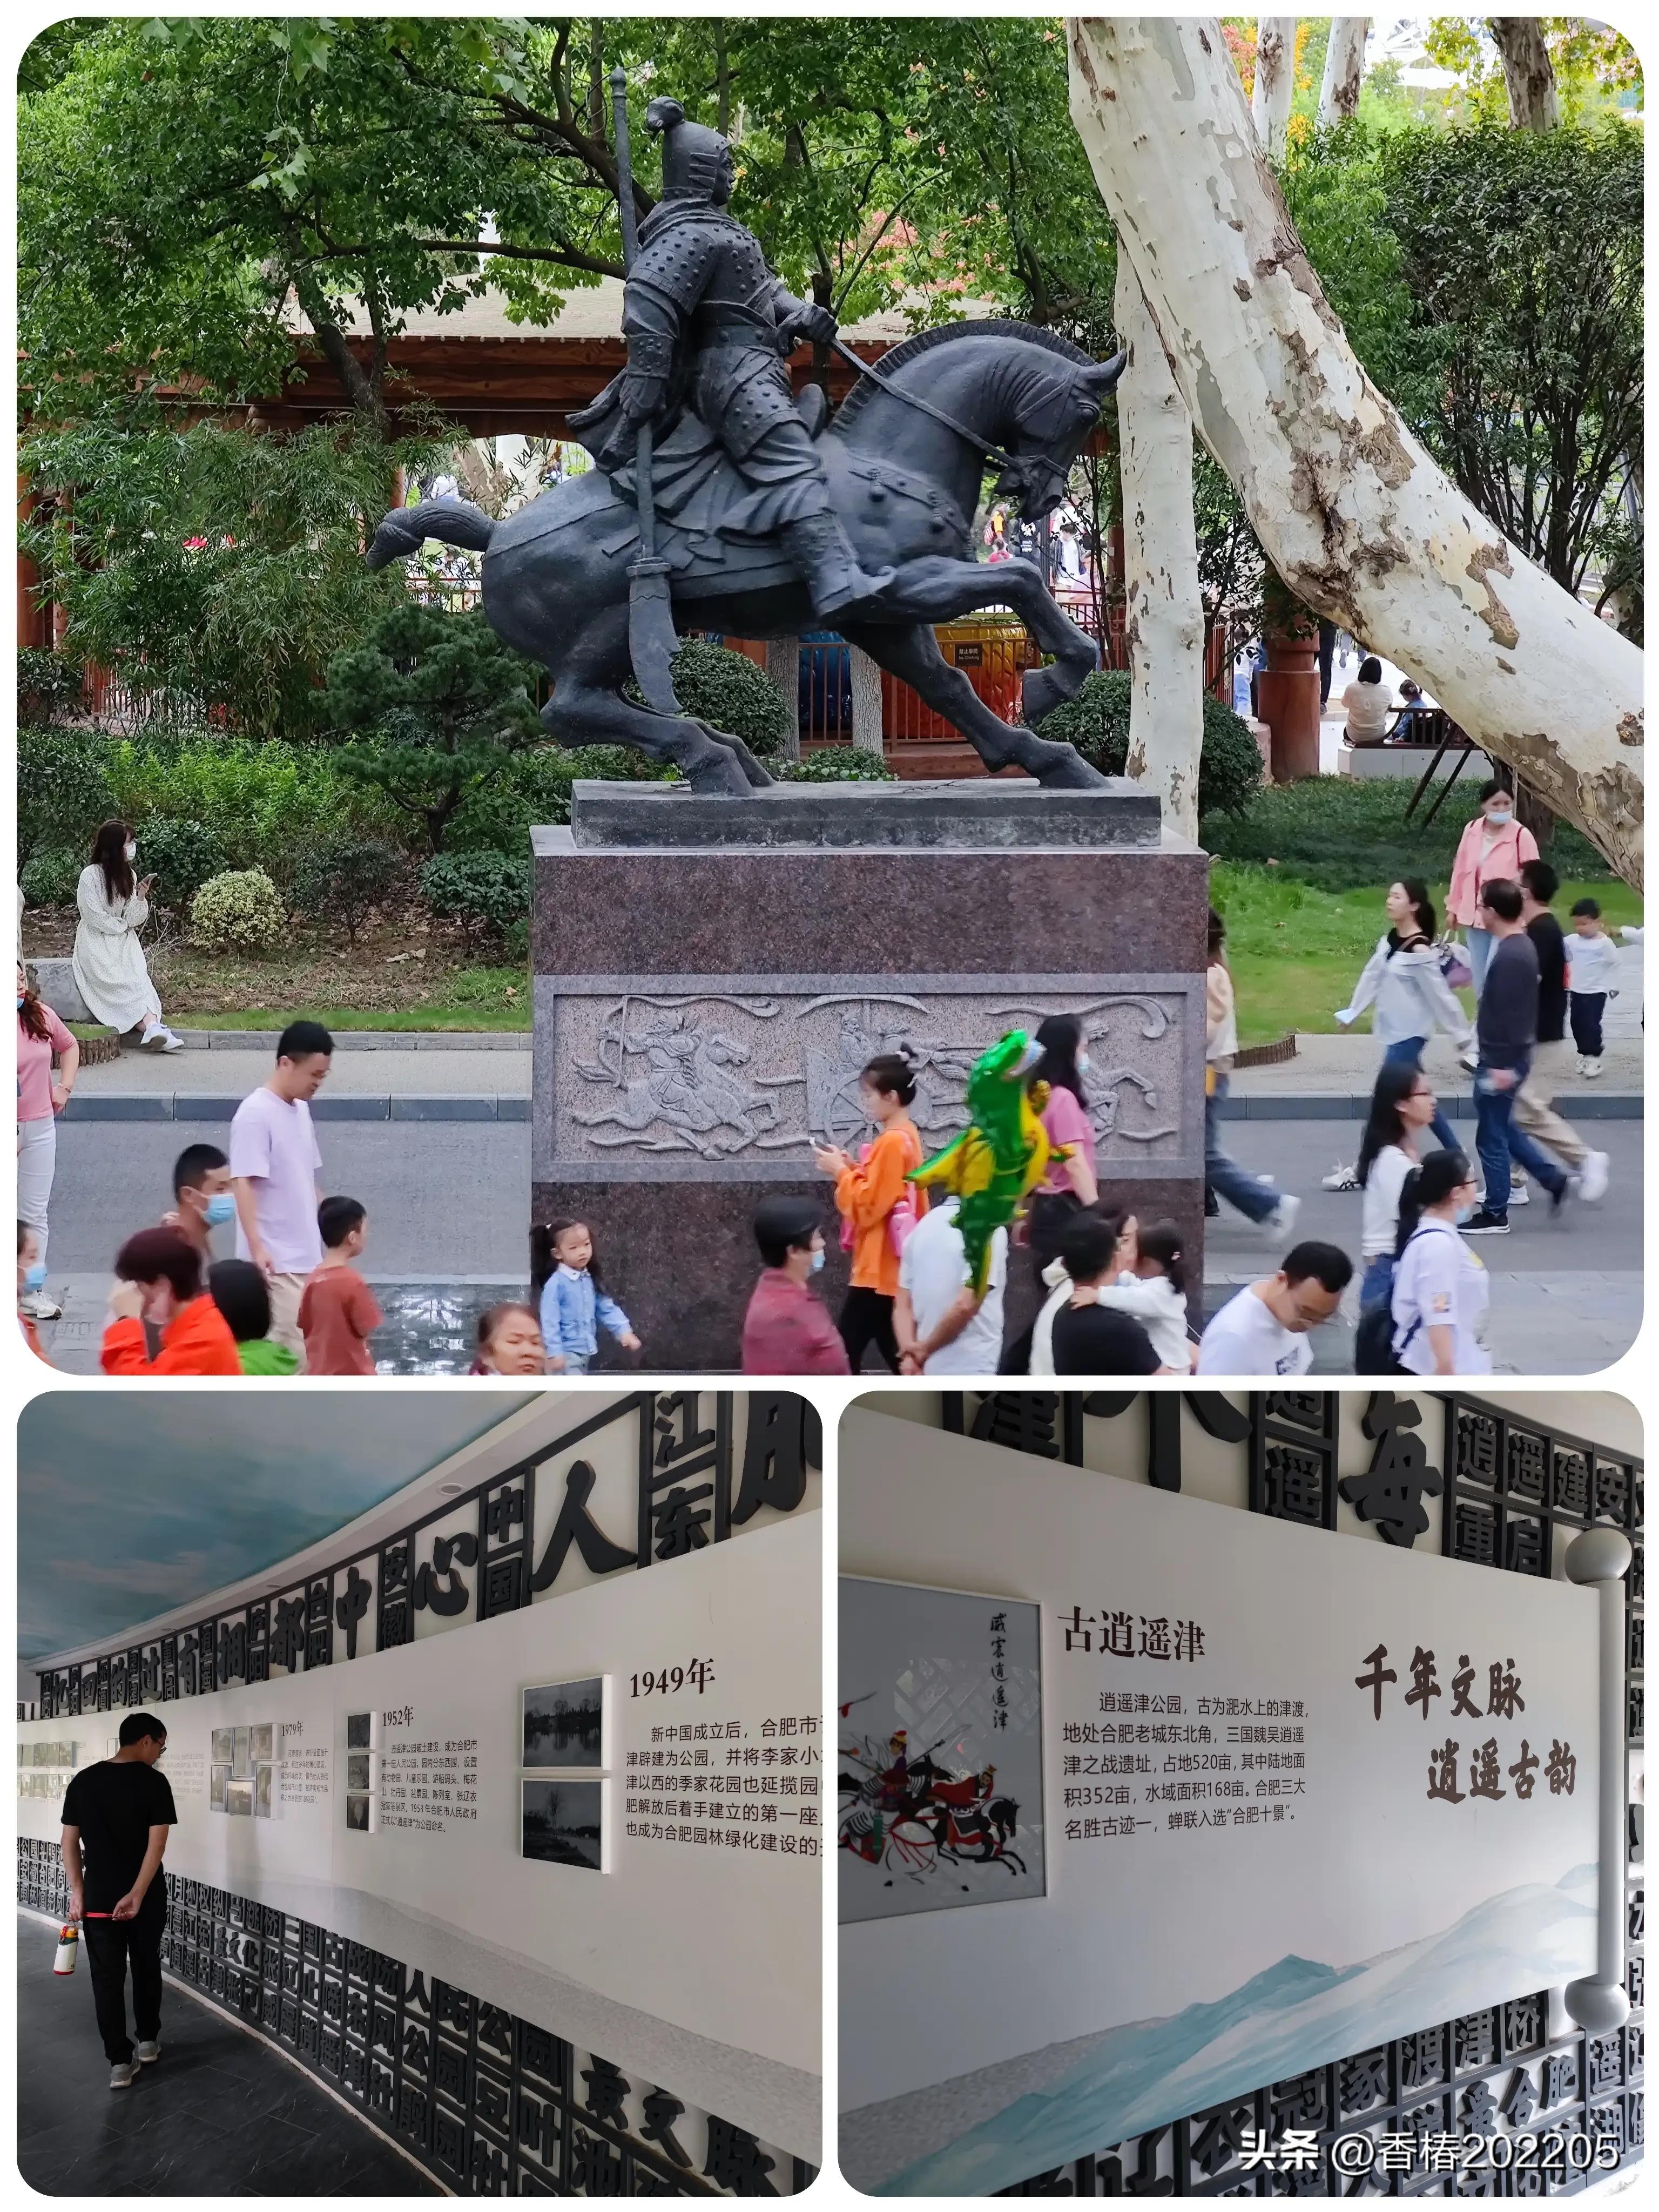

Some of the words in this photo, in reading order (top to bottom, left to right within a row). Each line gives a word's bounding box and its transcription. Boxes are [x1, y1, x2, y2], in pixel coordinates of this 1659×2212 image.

[530, 1459, 639, 1593] 人
[335, 1566, 373, 1661] 中
[1057, 1606, 1206, 1662] 古逍遥津
[630, 1658, 716, 1697] 1949年
[1354, 1643, 1525, 1721] 千年文脉
[282, 1720, 304, 1737] 1979年
[382, 1705, 414, 1727] 1952年
[1062, 1722, 1305, 1744] 地处合肥老城东北角，三国魏吴逍遥
[626, 1745, 822, 1768] 津辟建为公园，并将李家小
[1063, 1752, 1305, 1776] 津之战遗址，占地520亩，其中陆地面
[1426, 1737, 1577, 1804] 逍遥古韵
[625, 1775, 822, 1796] 津以西的季家花园也延揽园
[1063, 1777, 1306, 1809] 积352亩，水域面积168亩。合肥三大
[625, 1797, 822, 1826] 肥解放后着手建立的第一座
[625, 1821, 822, 1857] 也成为合肥园林绿化建设的
